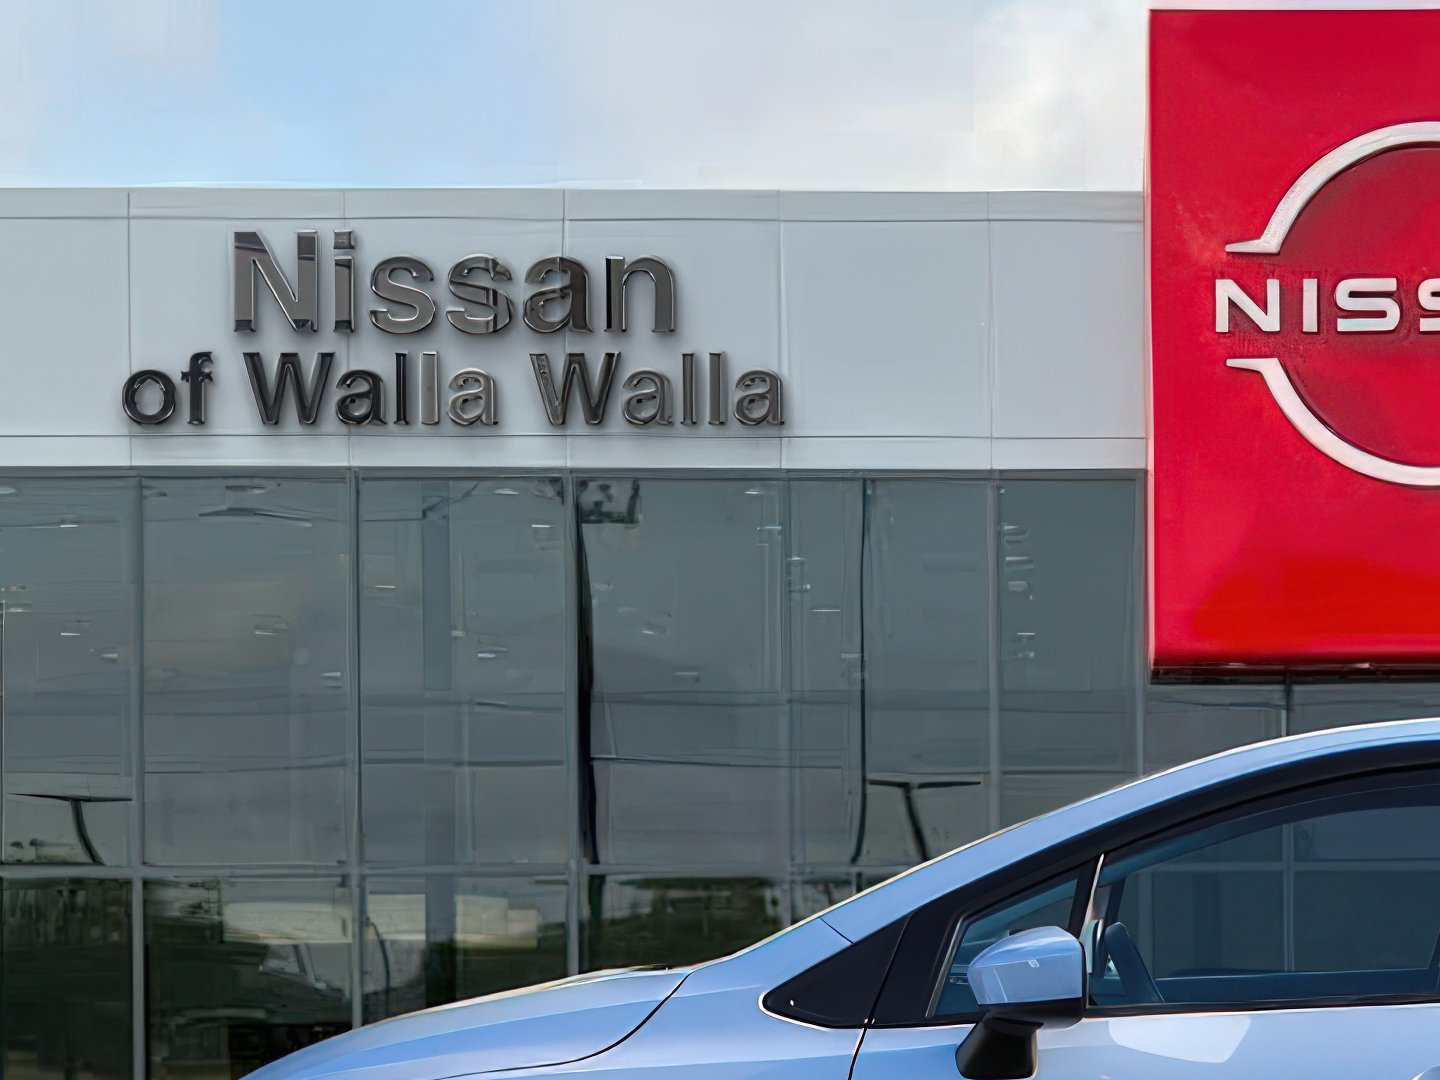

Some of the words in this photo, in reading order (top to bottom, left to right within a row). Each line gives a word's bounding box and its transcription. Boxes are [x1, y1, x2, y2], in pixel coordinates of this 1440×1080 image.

[232, 229, 678, 335] Nissan
[121, 351, 215, 426] of
[241, 351, 499, 427] Walla
[528, 351, 786, 427] Walla
